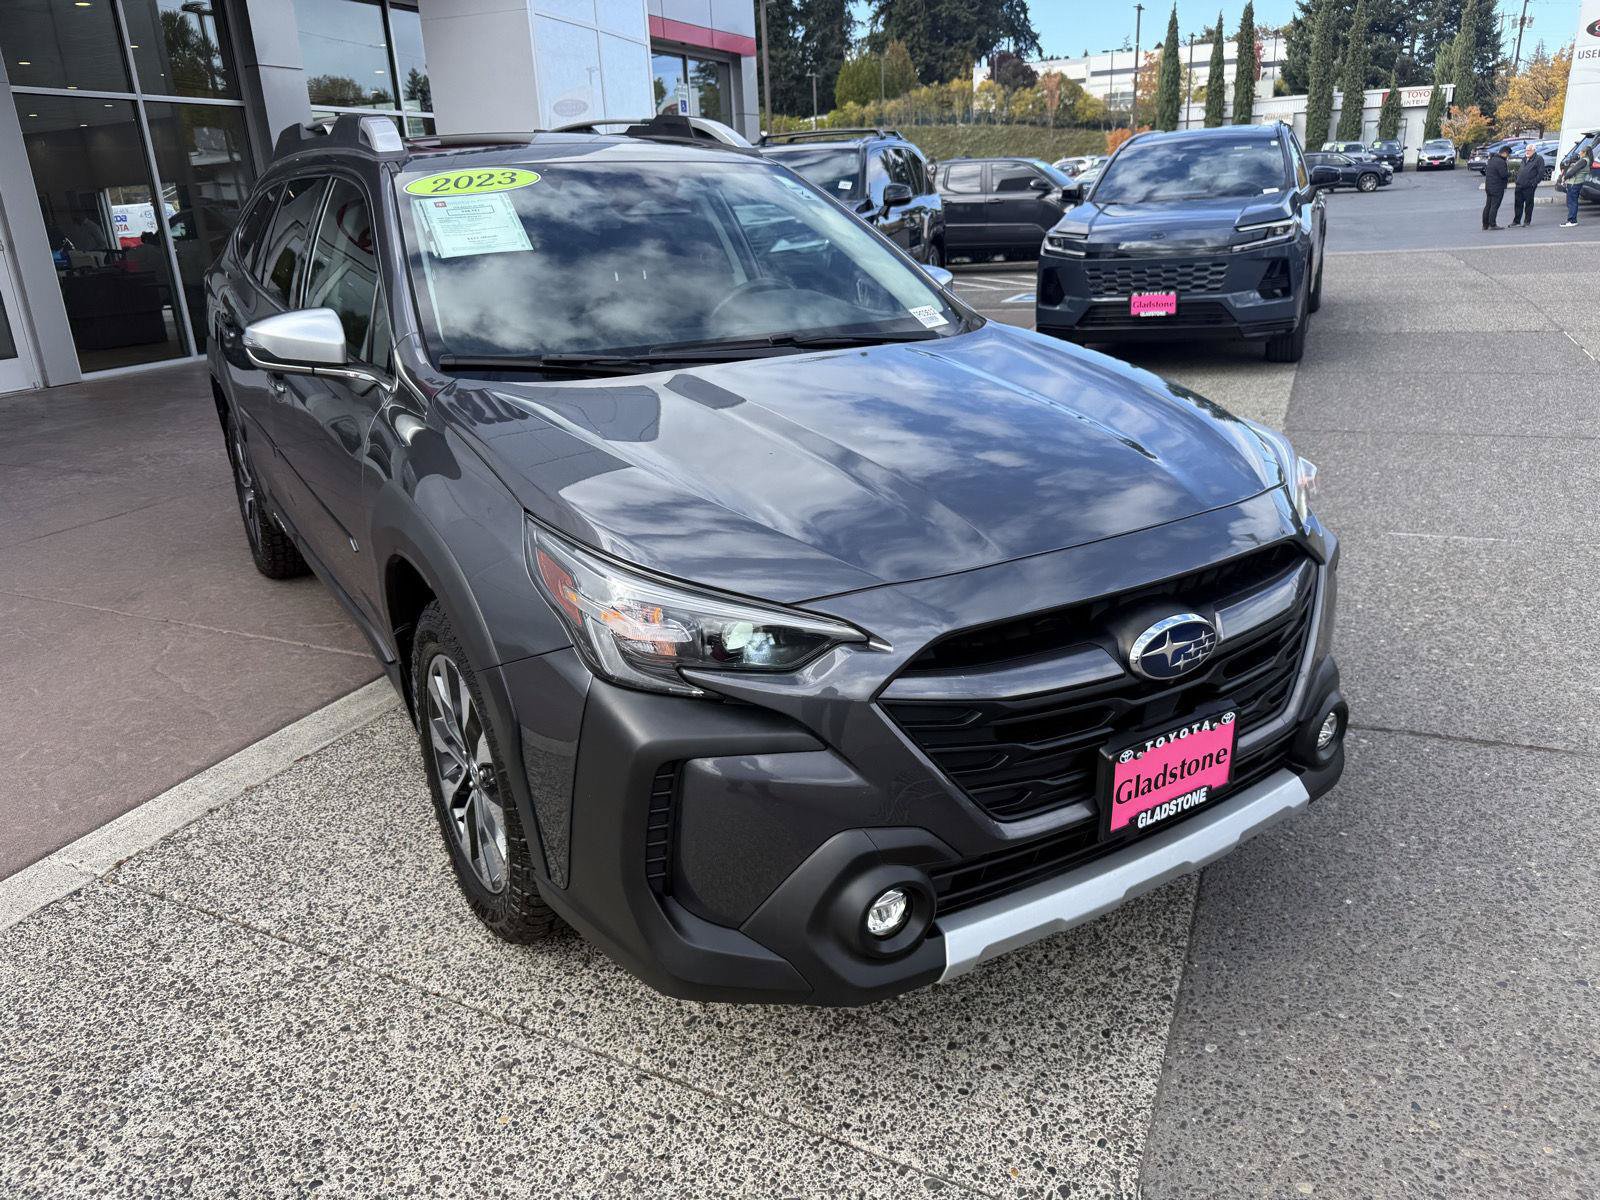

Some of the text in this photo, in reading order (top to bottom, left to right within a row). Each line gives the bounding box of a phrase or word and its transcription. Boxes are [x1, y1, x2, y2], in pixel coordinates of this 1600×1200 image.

[431, 171, 517, 193] 2023
[1133, 301, 1174, 309] Gladstone
[1145, 720, 1210, 753] TOYOTA
[1116, 747, 1228, 805] Gladstone
[1137, 786, 1208, 829] GLADSTONE
